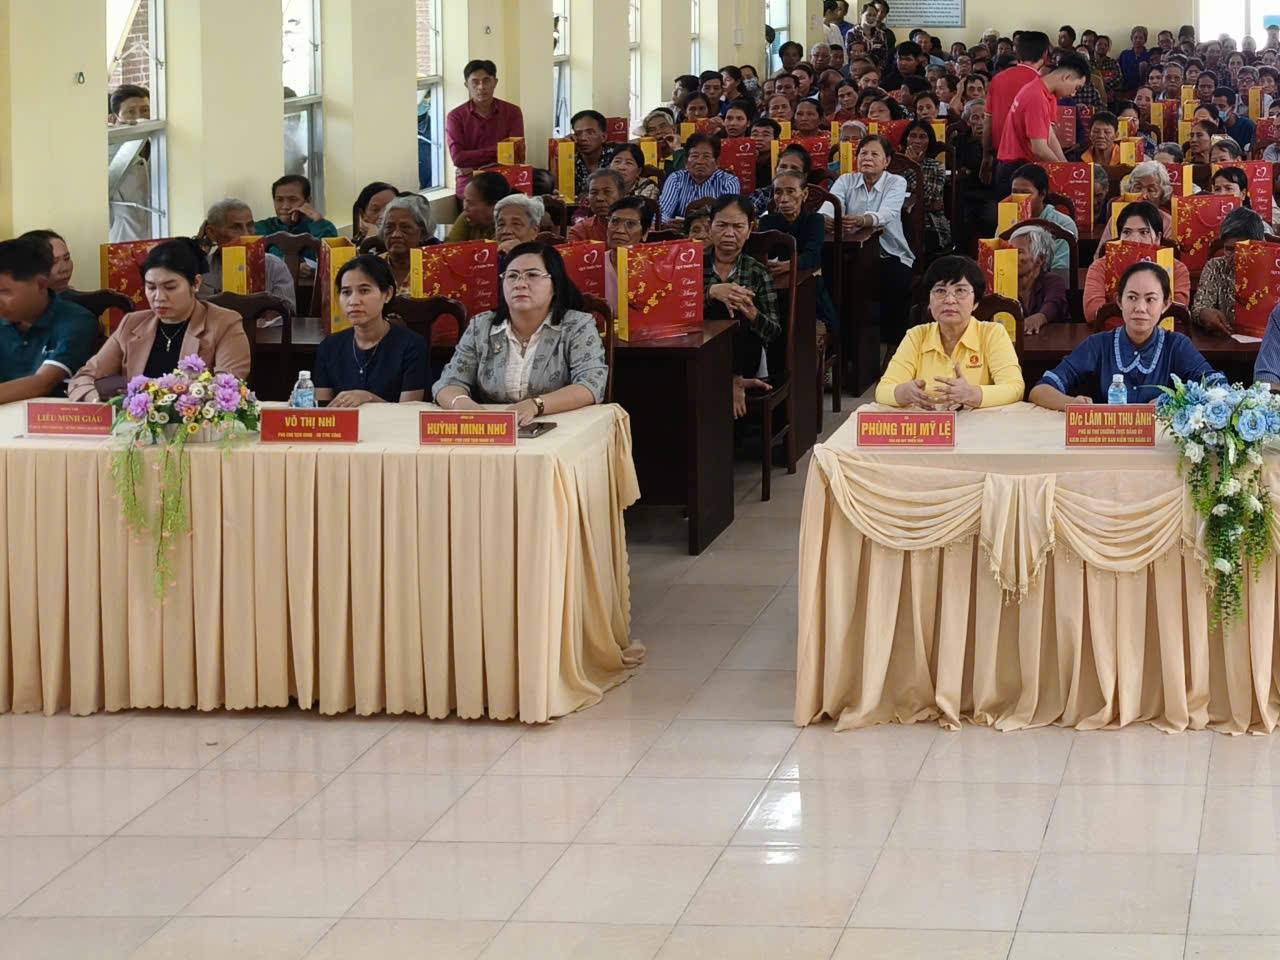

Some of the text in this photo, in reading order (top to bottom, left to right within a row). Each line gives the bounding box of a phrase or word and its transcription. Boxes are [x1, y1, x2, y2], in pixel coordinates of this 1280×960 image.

[284, 414, 298, 427] VÕ
[300, 416, 315, 429] THỊ
[427, 420, 507, 435] HUỲNH MINH NHƯ
[1084, 409, 1102, 426] LÂM
[1103, 411, 1117, 429] THỊ
[1118, 411, 1133, 426] THU
[861, 420, 951, 439] PHÙNG THỊ MỸ LỆ
